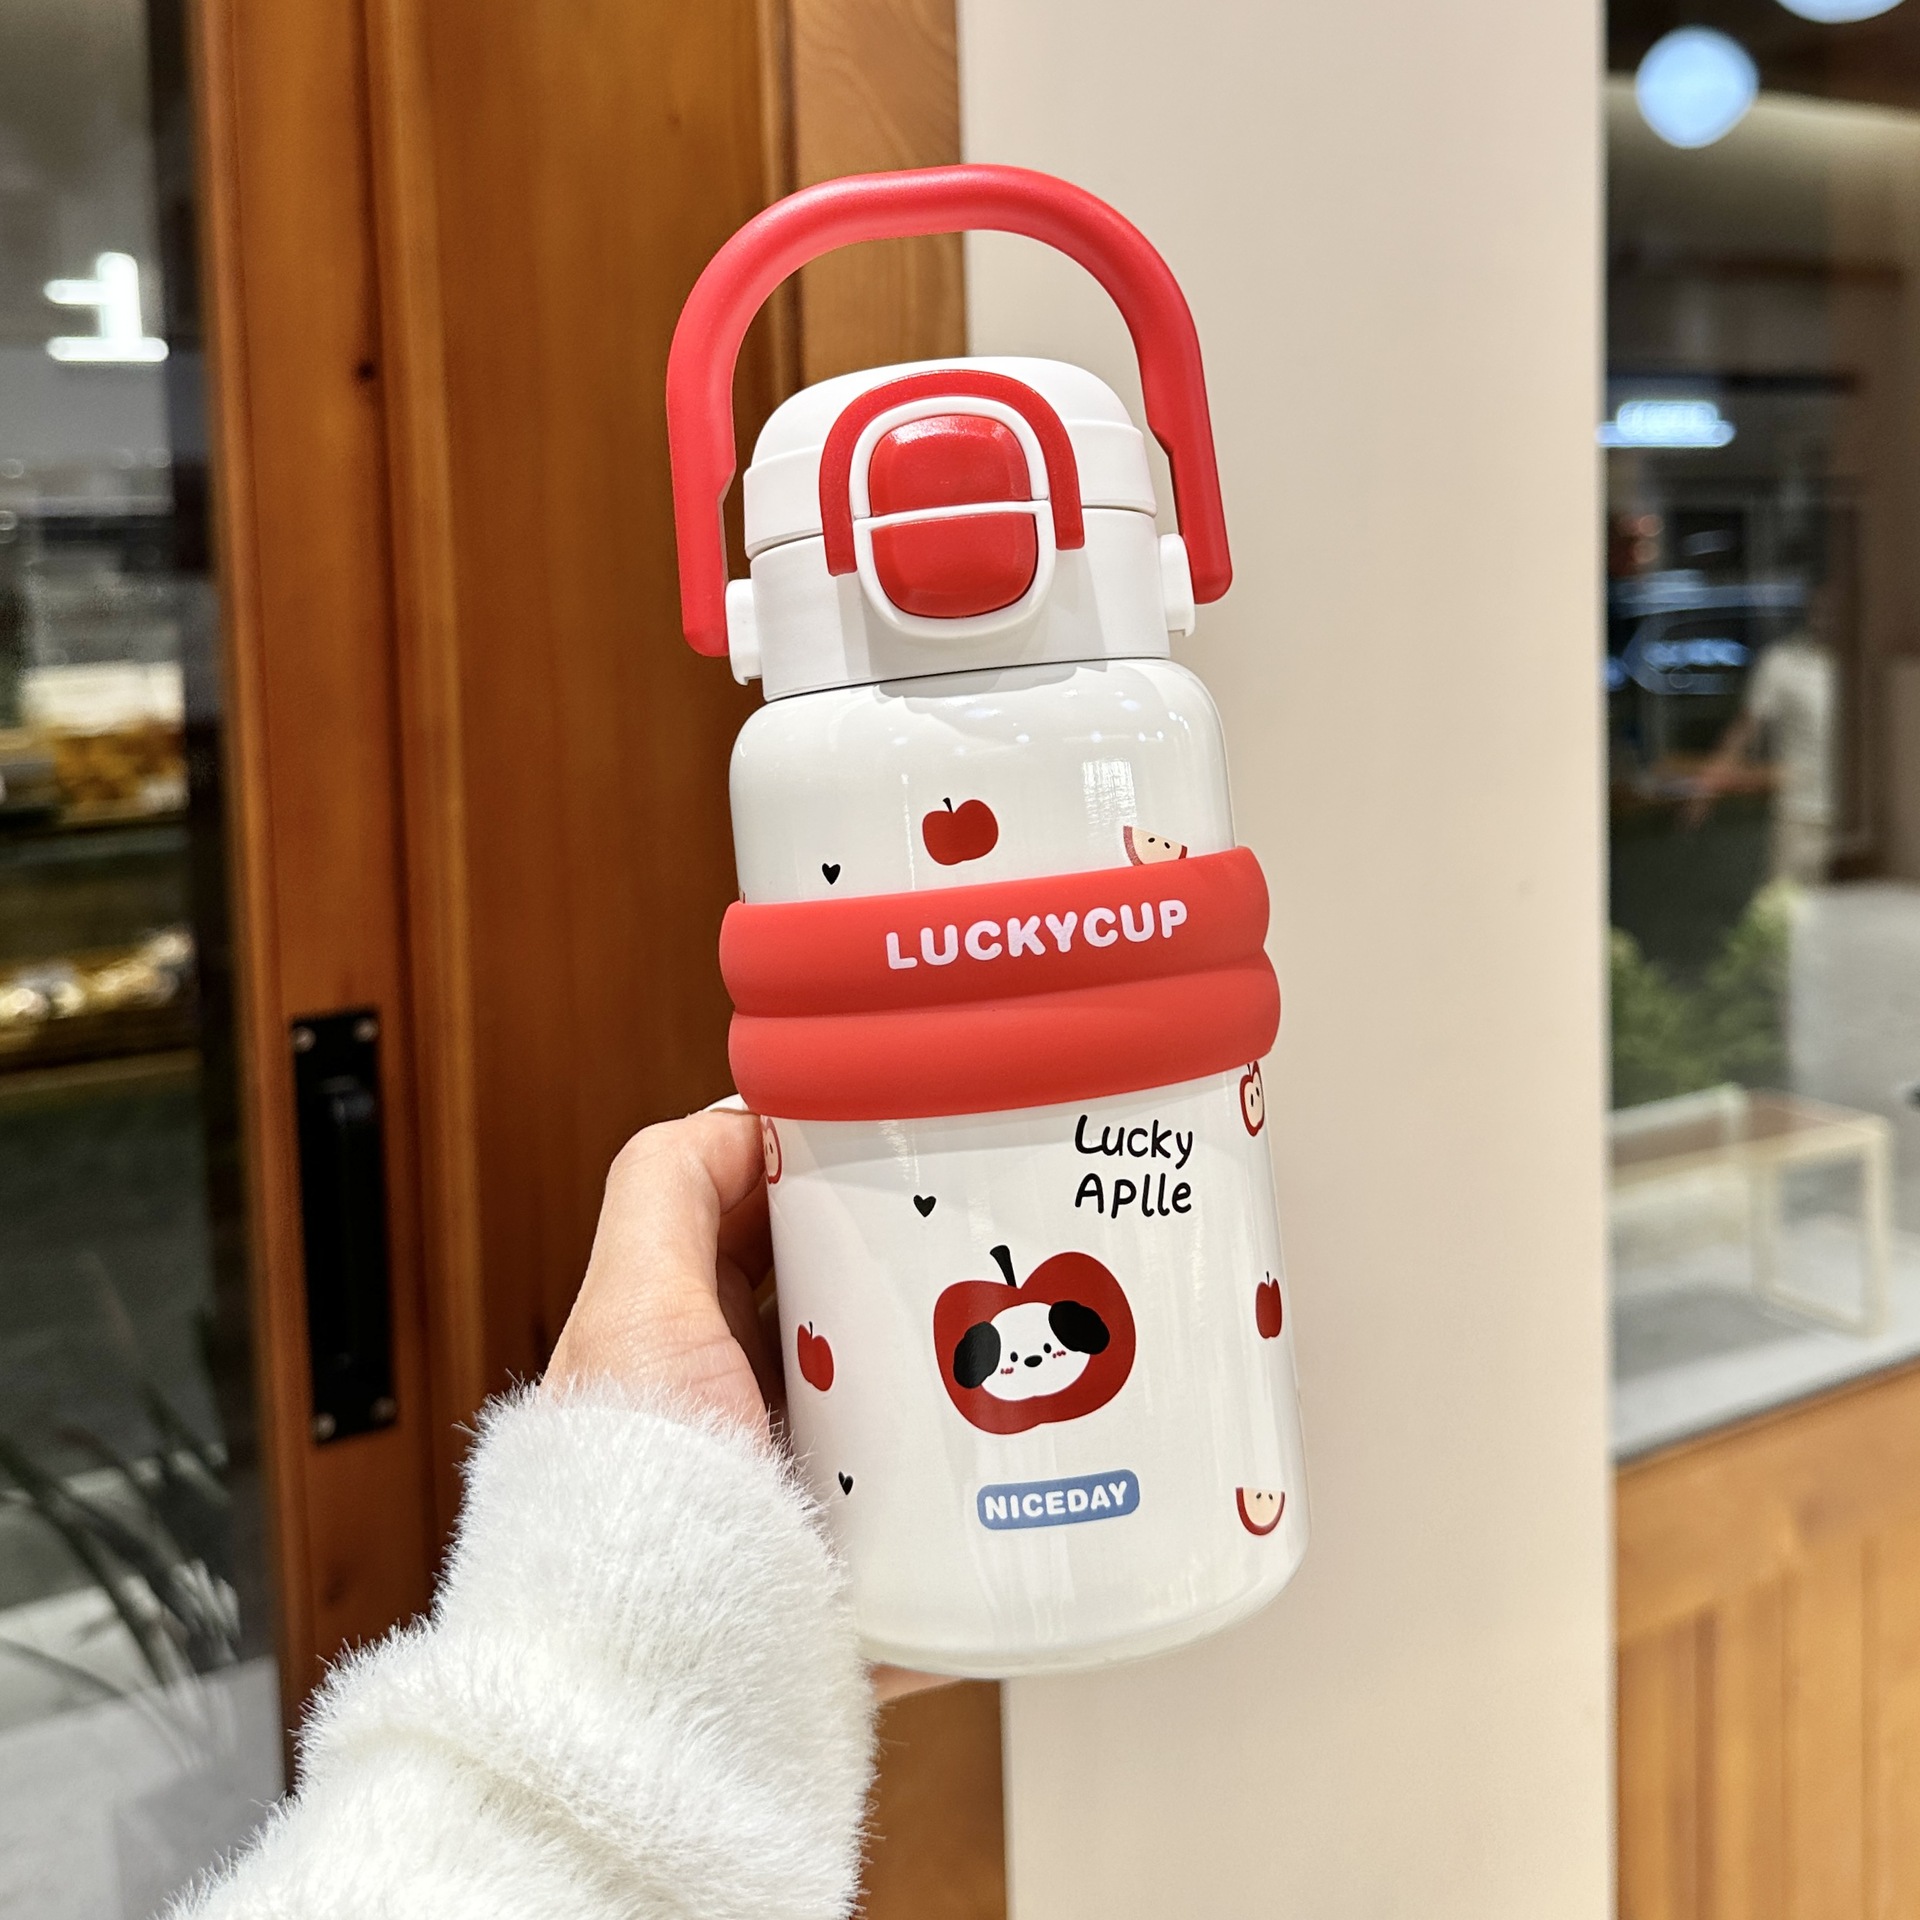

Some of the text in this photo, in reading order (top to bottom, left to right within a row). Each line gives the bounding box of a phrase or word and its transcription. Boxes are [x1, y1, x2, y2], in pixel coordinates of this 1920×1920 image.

[885, 899, 1188, 970] LUCKYCUP
[1074, 1114, 1193, 1170] Lucky
[984, 1480, 1128, 1520] NICEDAY
